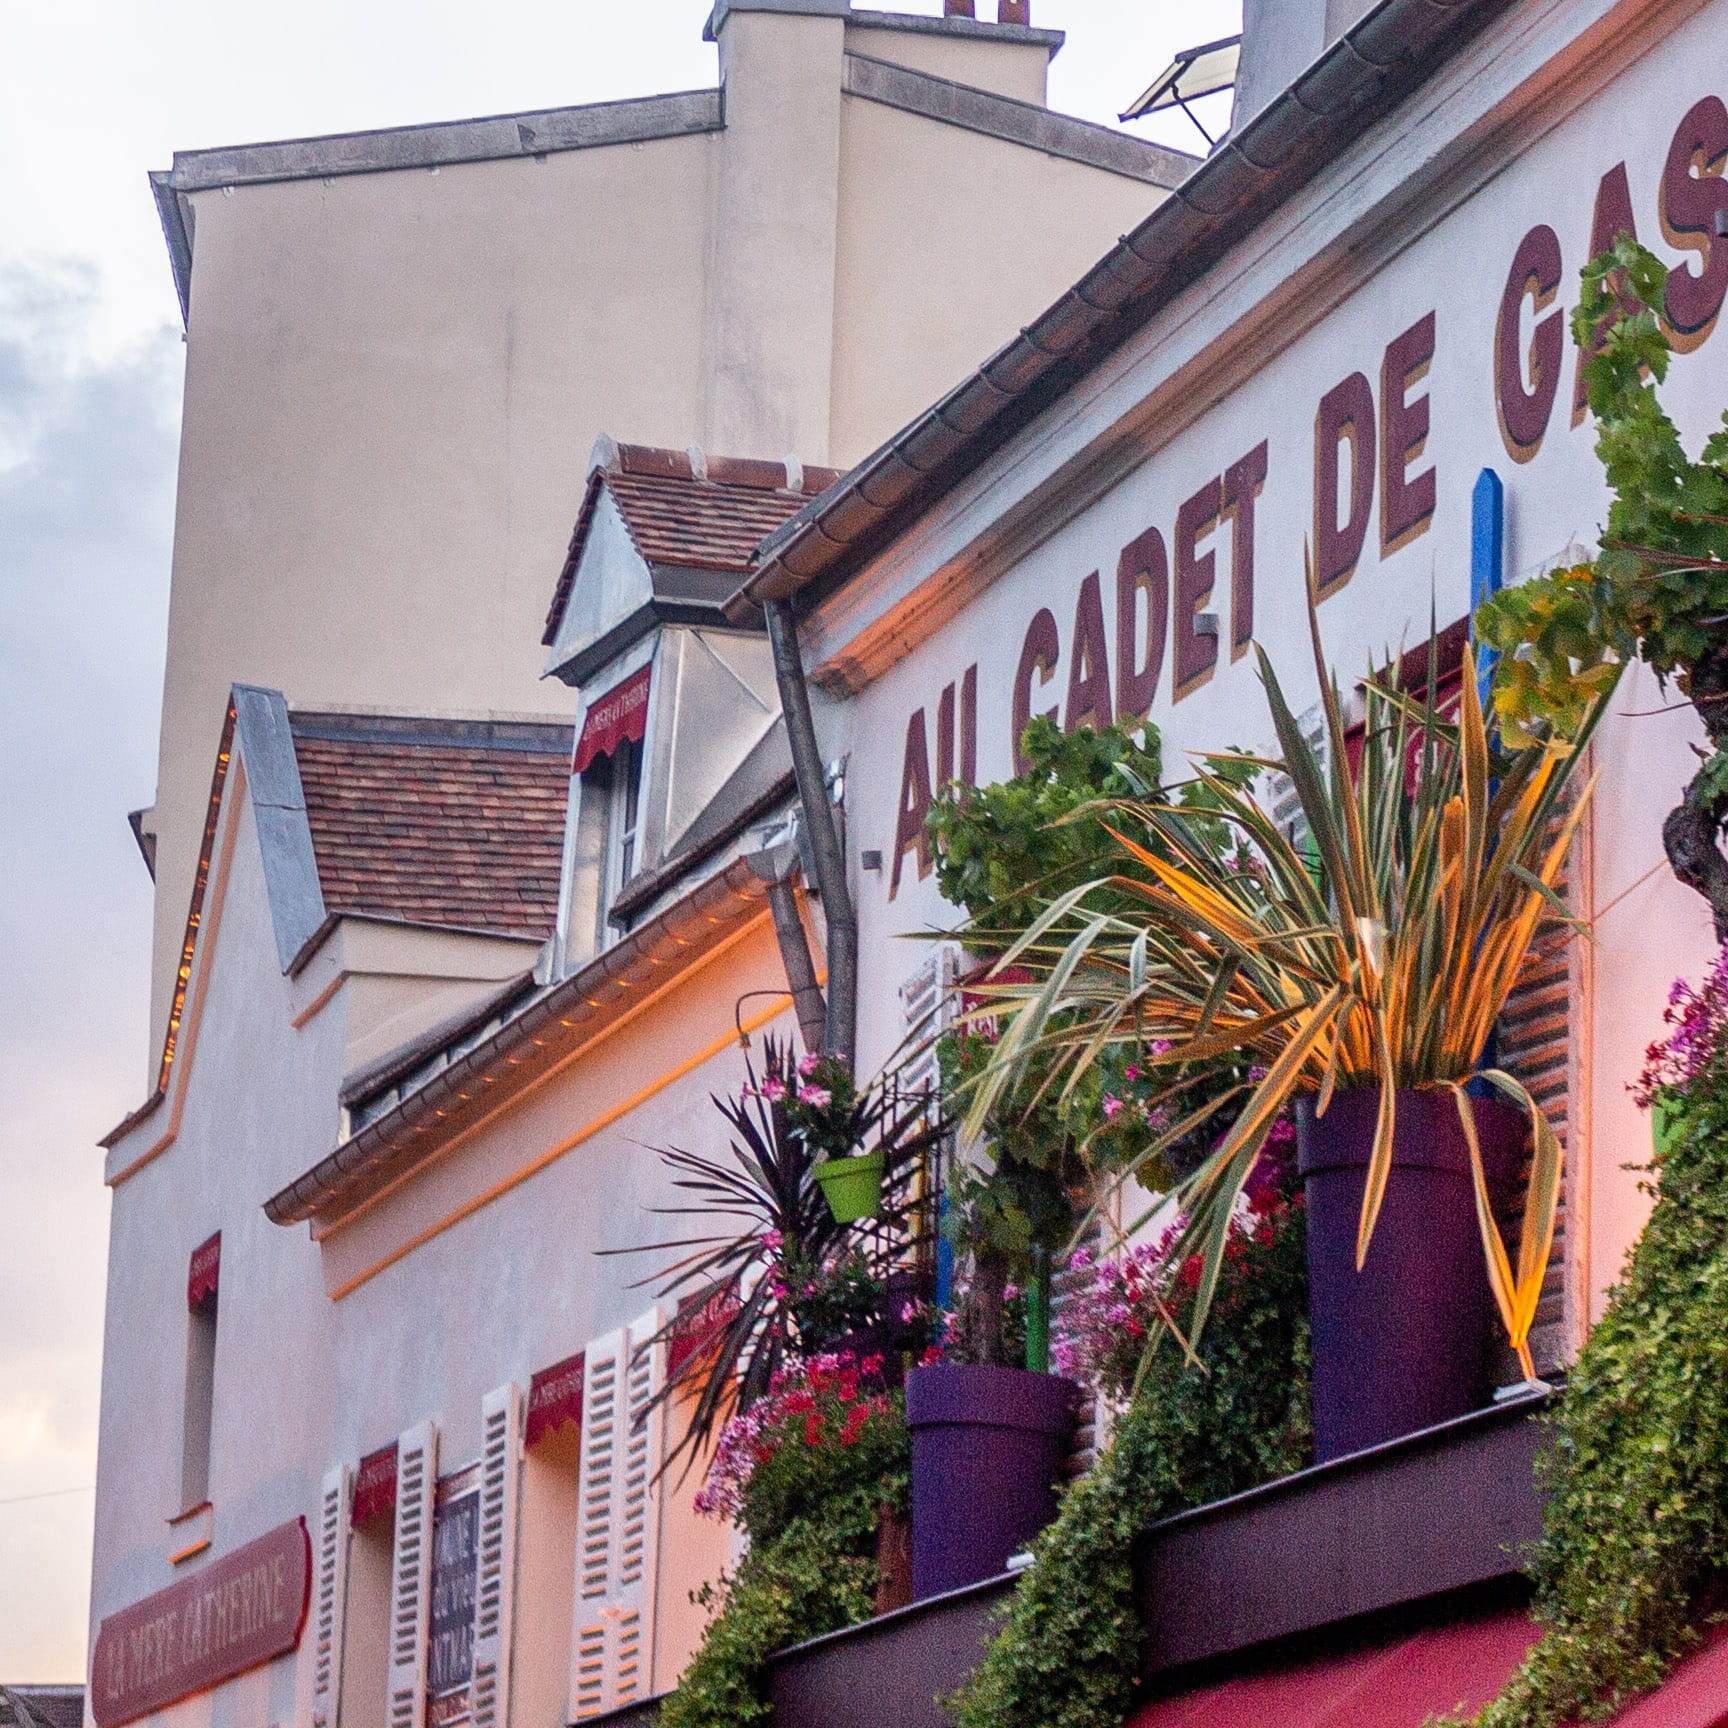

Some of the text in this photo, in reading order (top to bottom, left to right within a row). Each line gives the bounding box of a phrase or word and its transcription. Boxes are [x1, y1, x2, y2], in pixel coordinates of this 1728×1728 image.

[1011, 438, 1270, 779] CADET
[1312, 309, 1438, 604] DE
[182, 1552, 286, 1666] CATHERINE
